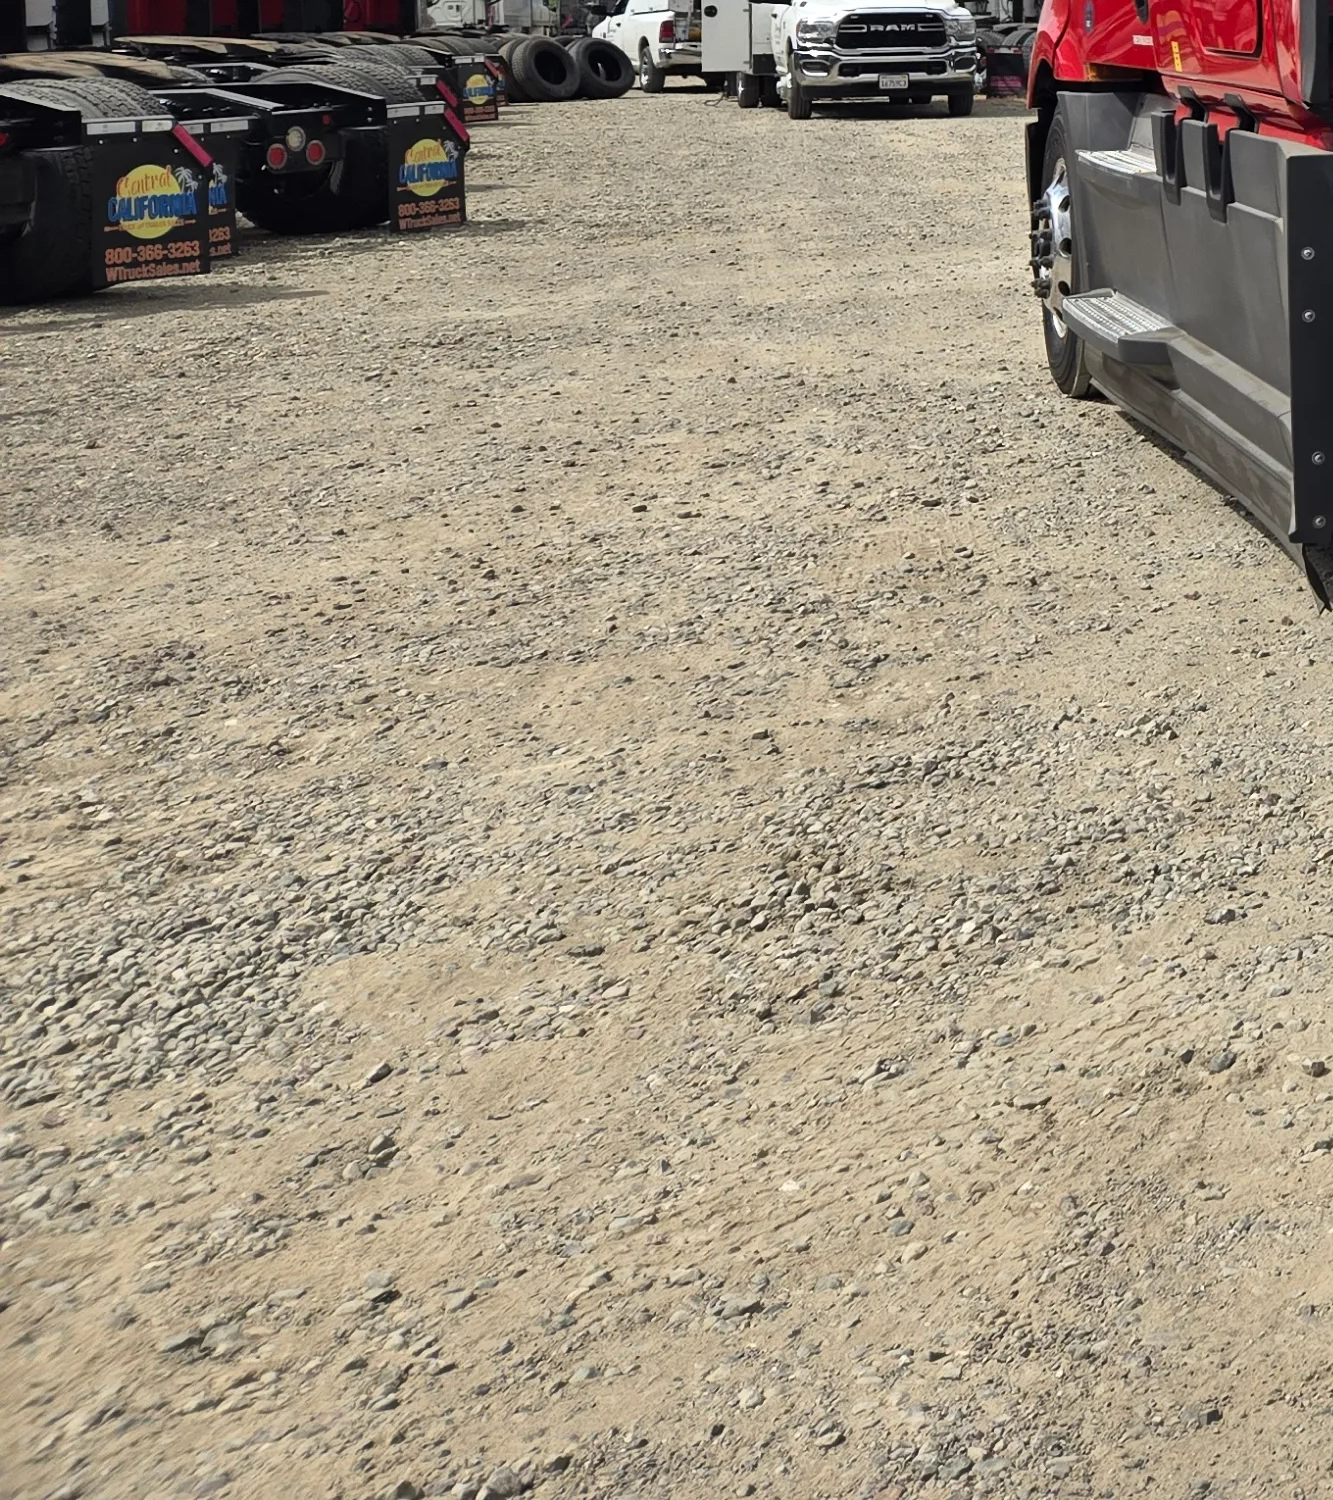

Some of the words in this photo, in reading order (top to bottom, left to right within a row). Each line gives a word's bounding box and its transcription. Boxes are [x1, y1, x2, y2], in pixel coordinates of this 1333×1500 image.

[870, 24, 916, 32] RAM
[116, 164, 172, 197] Central
[107, 189, 198, 223] CALIFORNIA
[104, 239, 200, 266] 800-366-3263
[105, 258, 201, 282] WTruckSales.net
